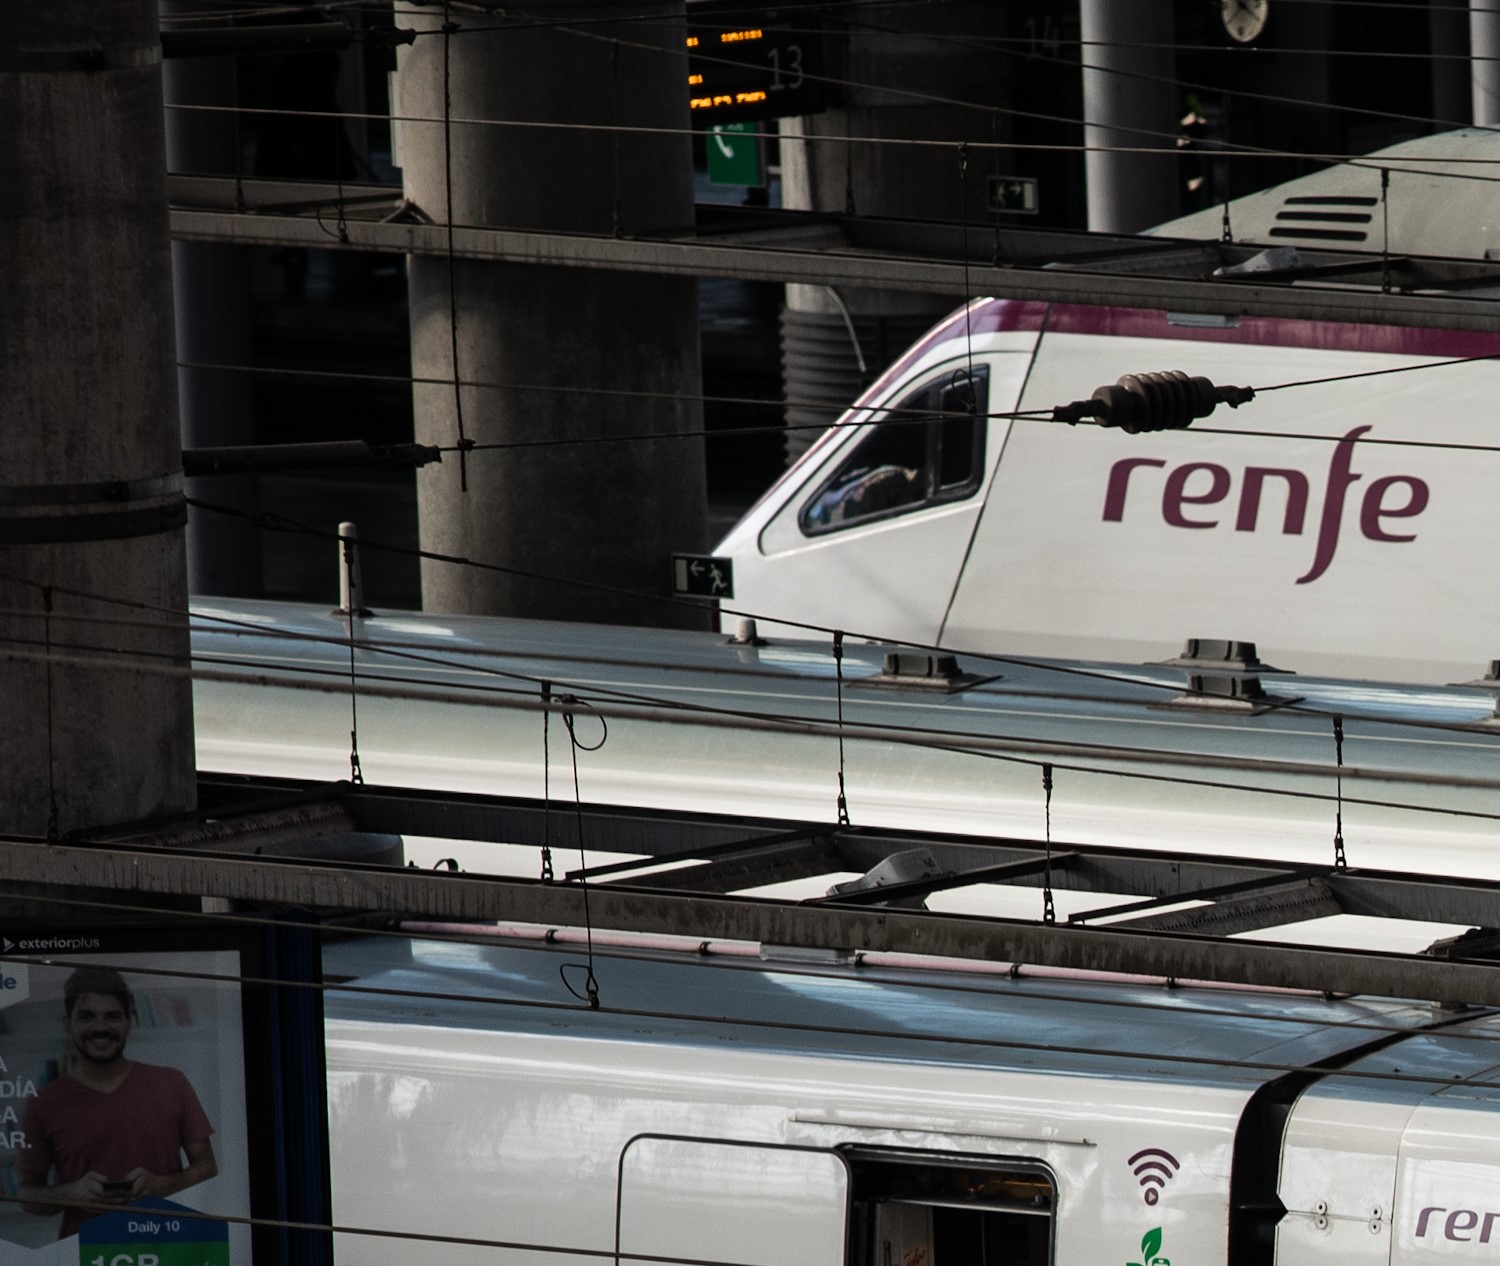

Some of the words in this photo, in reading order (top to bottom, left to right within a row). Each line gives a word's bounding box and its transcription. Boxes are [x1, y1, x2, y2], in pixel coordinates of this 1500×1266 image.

[767, 45, 803, 91] 13
[1102, 425, 1430, 585] renfe
[19, 937, 101, 950] exteriorplus
[128, 1221, 160, 1235] Daily
[166, 1221, 180, 1232] 10
